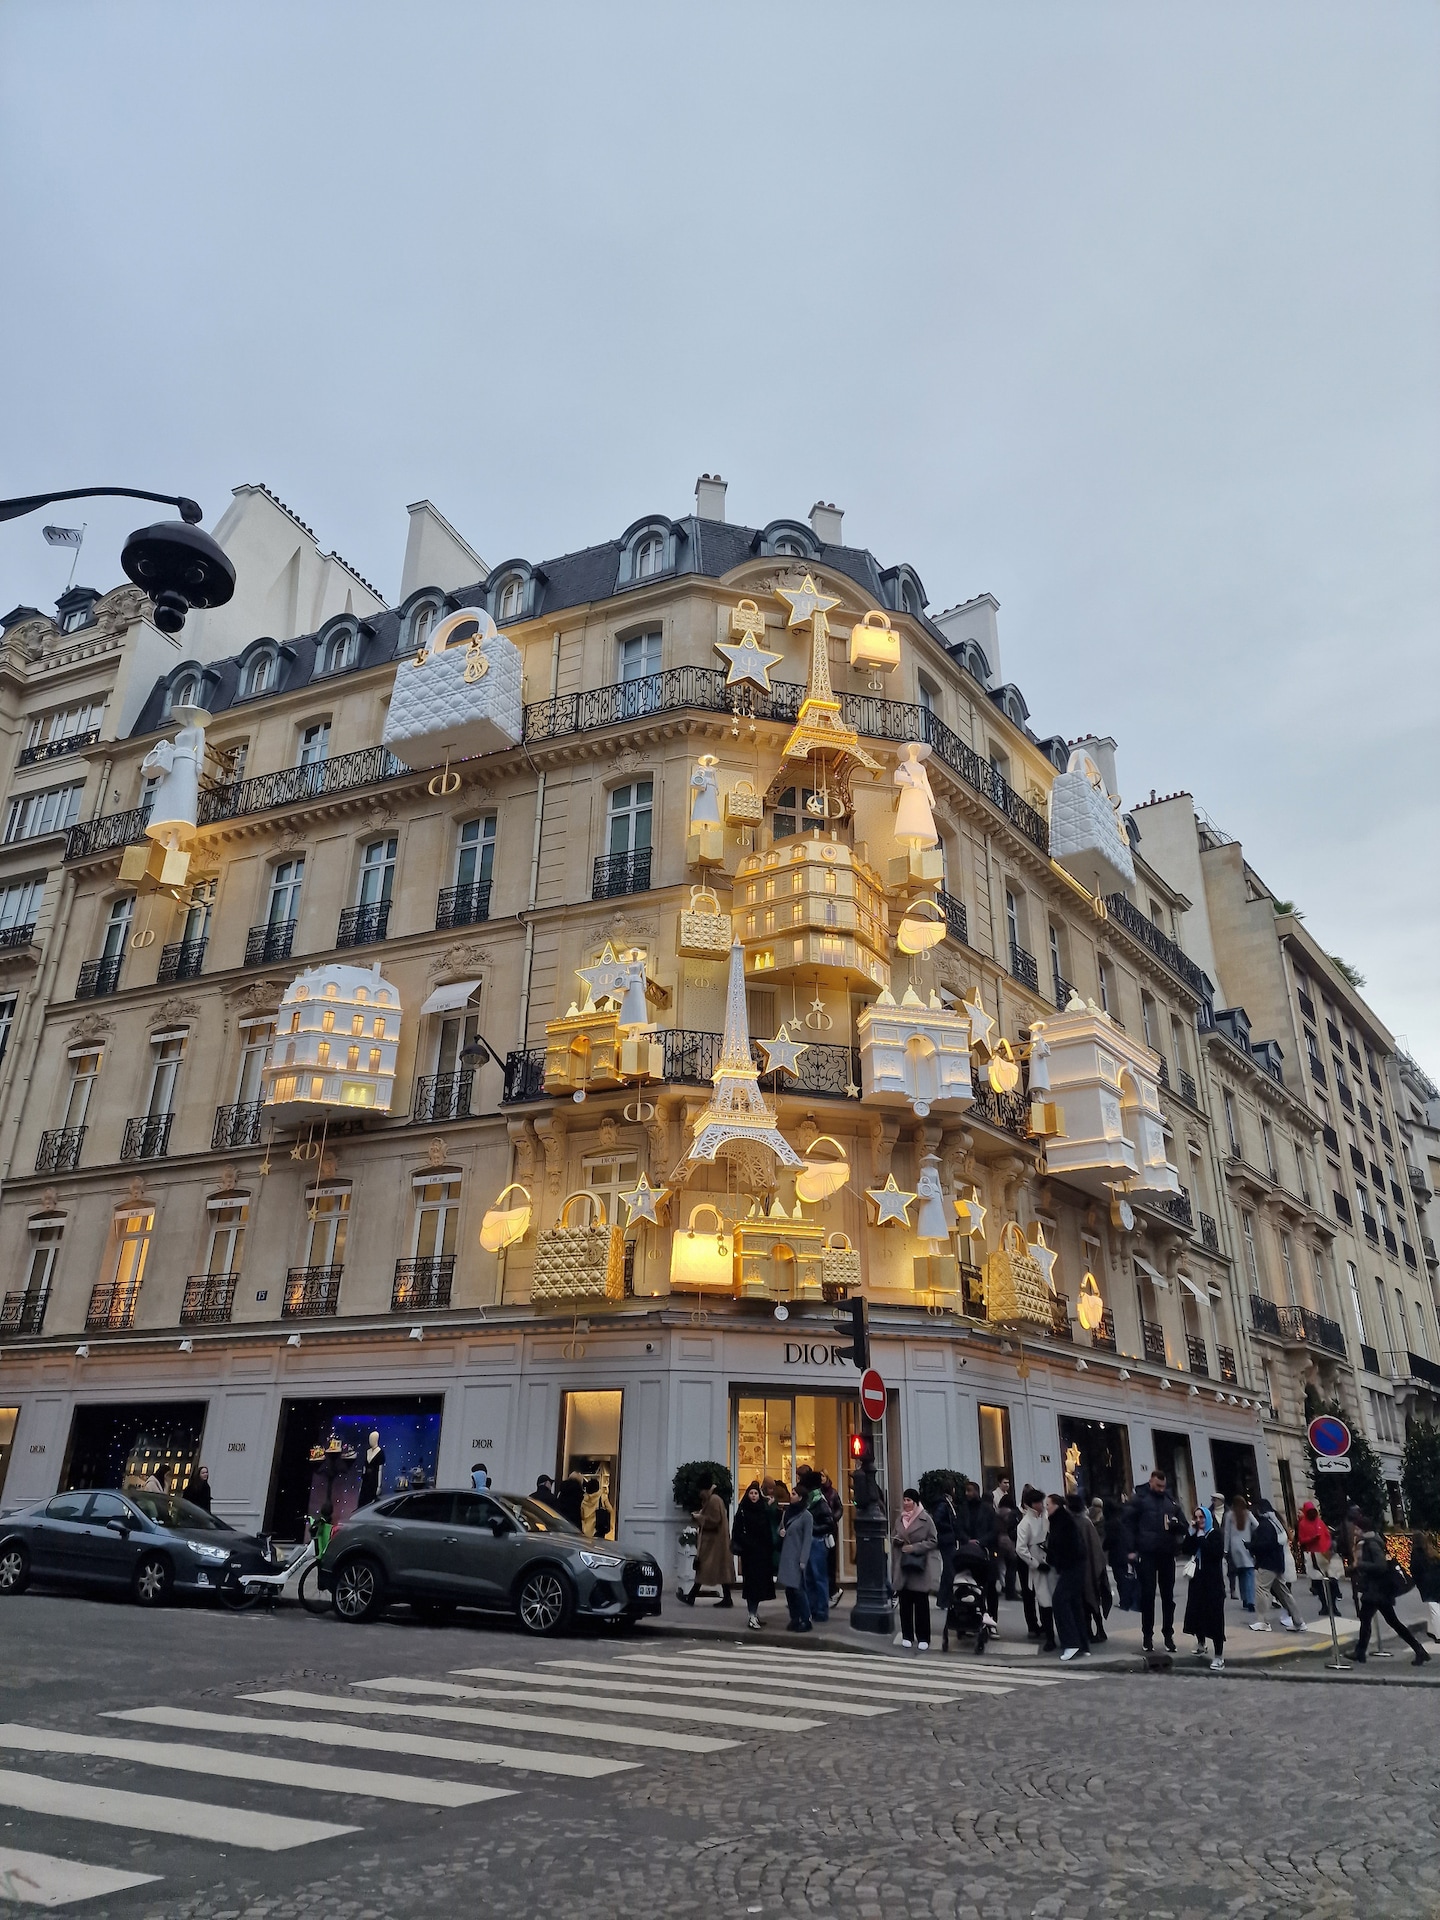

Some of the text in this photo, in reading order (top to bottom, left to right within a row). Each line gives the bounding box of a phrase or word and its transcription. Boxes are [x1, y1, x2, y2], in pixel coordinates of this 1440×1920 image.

[783, 1342, 847, 1367] DIOR
[227, 1442, 246, 1452] DIOR
[472, 1439, 493, 1448] DIOR
[29, 1445, 46, 1453] DIOR
